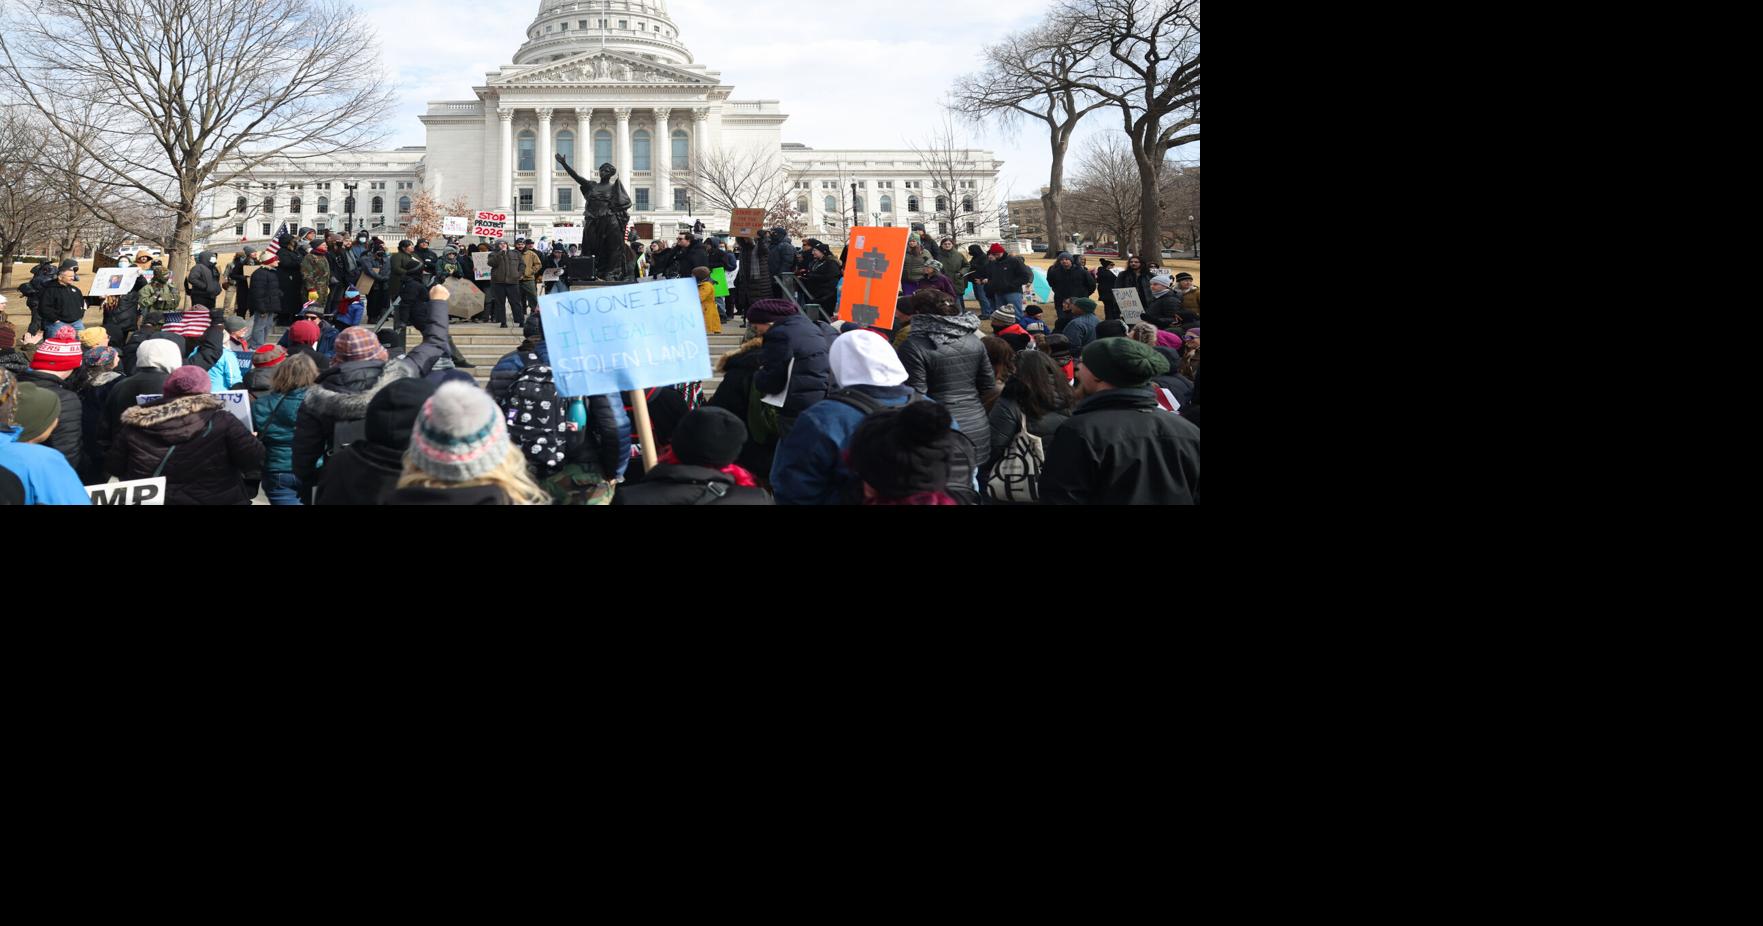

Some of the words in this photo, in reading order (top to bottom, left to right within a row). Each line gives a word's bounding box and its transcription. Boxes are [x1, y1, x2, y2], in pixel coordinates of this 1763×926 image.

[475, 220, 506, 228] PROJECT
[479, 212, 505, 221] STOP
[475, 227, 503, 237] 2025
[556, 298, 591, 317] NO
[596, 291, 644, 314] ONE
[652, 286, 679, 306] IS
[557, 322, 656, 349] ILLEGAL
[664, 311, 696, 334] ON
[557, 351, 641, 373] STOLEN
[647, 340, 698, 367] LAND
